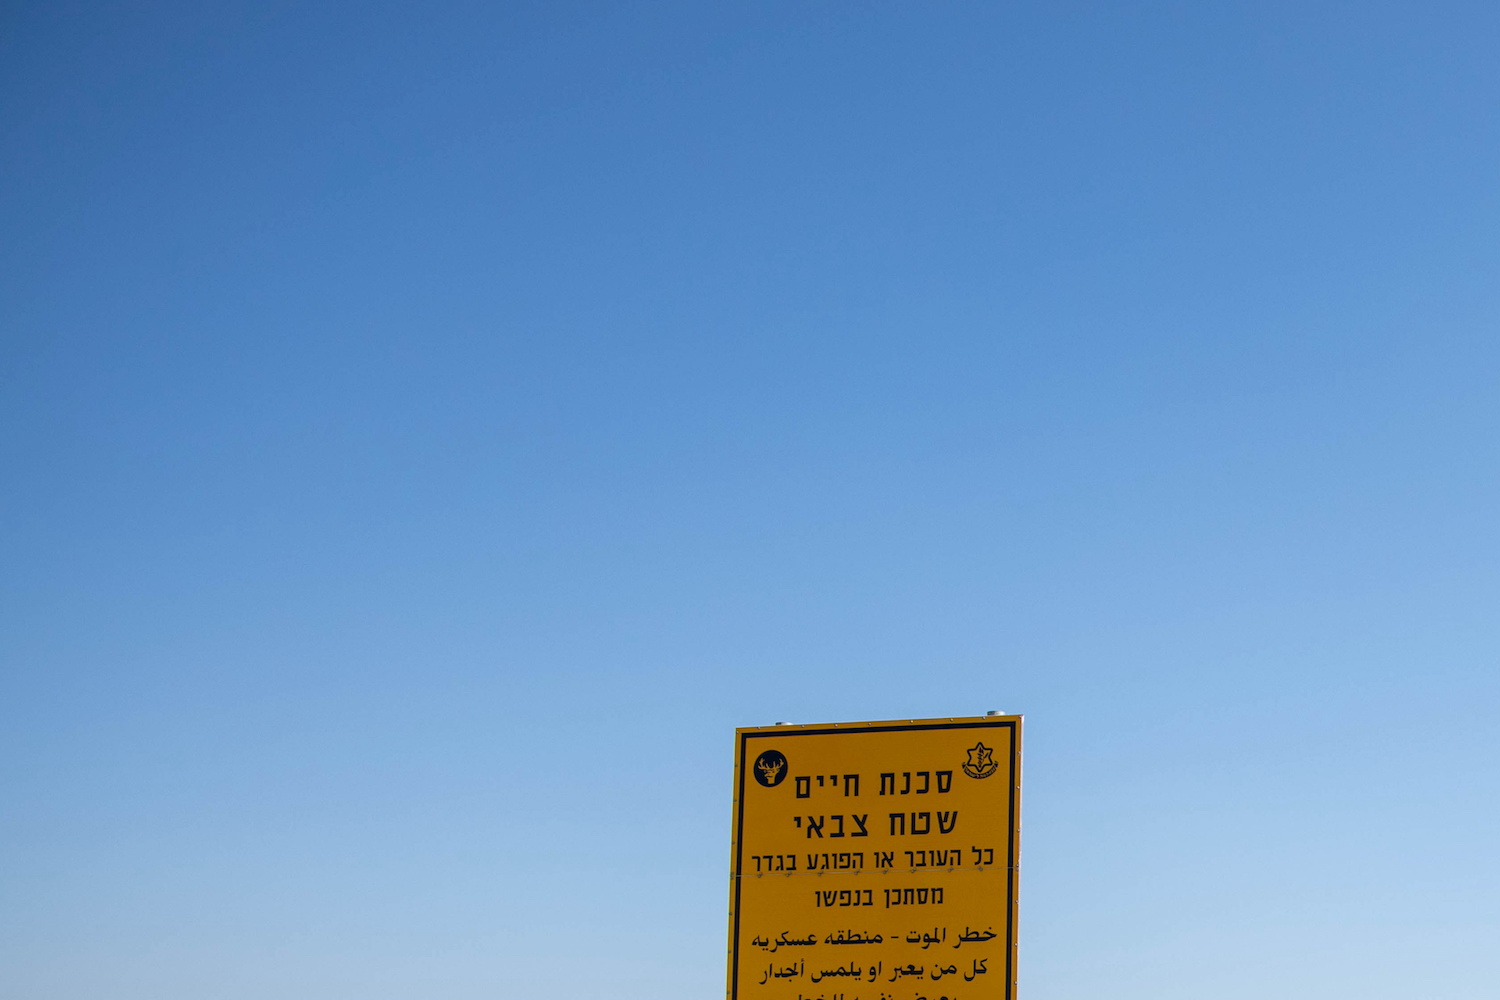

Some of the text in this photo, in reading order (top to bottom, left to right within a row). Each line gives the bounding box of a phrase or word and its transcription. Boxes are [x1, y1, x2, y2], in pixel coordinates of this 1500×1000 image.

[794, 773, 860, 799] חיים
[878, 770, 954, 796] סכנת
[793, 810, 959, 839] שטח צבאי
[751, 845, 994, 872] כל העובר או הפוגע בגדר
[814, 887, 944, 909] מסתכן בנפשו
